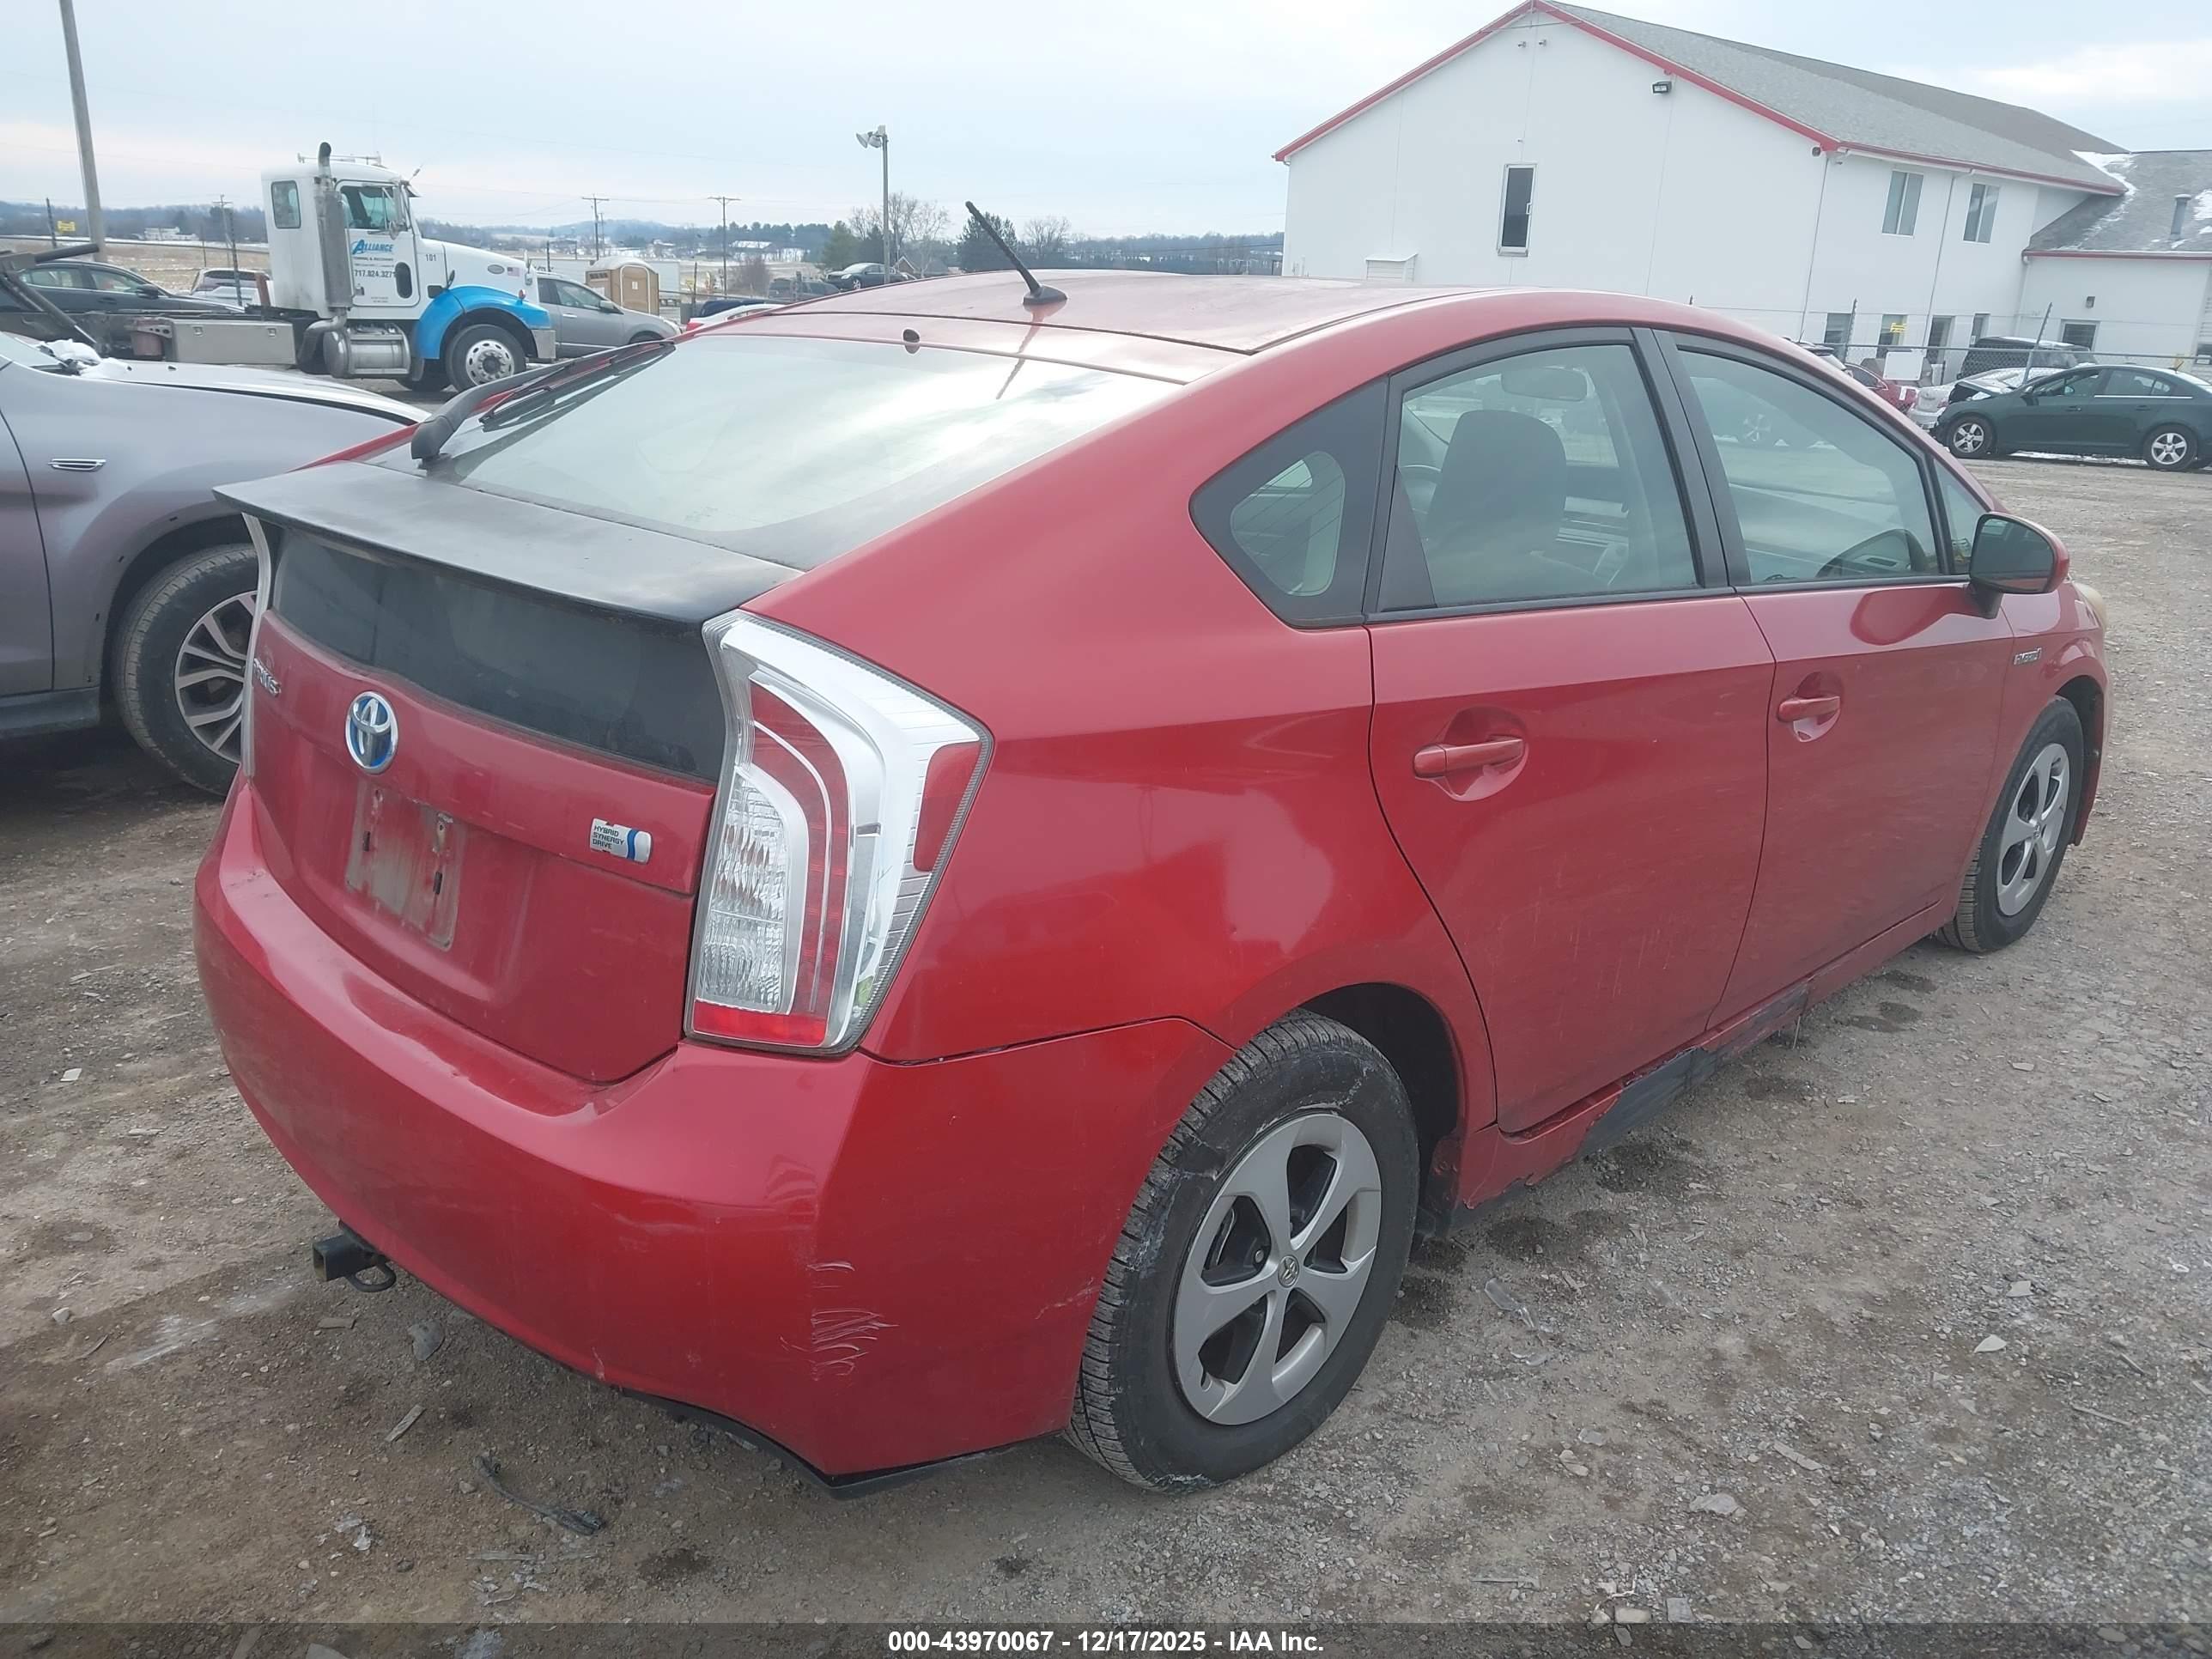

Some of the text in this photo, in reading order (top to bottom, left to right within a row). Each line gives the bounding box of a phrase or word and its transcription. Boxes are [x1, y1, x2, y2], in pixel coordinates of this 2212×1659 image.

[594, 825, 619, 837] HYBRID
[592, 831, 625, 846] SYNERGY
[592, 838, 613, 849] DRIVE
